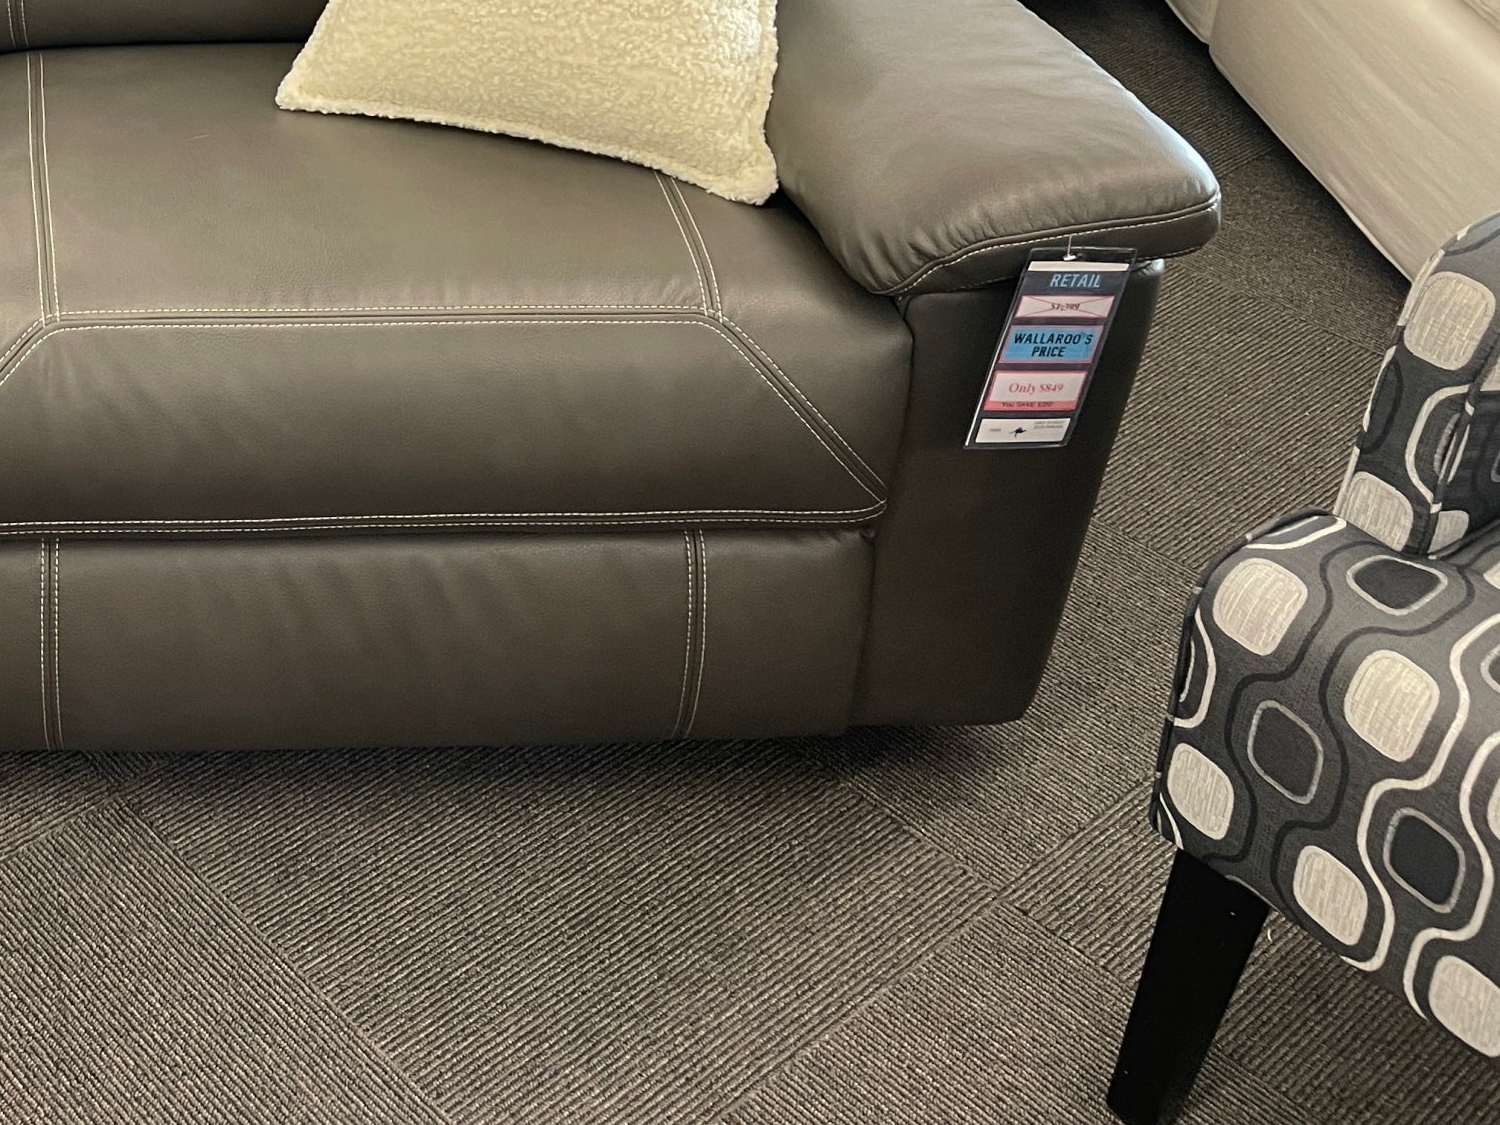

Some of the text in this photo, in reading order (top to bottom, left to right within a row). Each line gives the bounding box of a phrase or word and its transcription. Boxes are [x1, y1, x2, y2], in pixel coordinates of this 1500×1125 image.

[1049, 273, 1103, 289] RETAIL
[1013, 332, 1094, 346] WALLAROO'S
[1031, 346, 1067, 358] PRICE
[1008, 382, 1036, 395] Only
